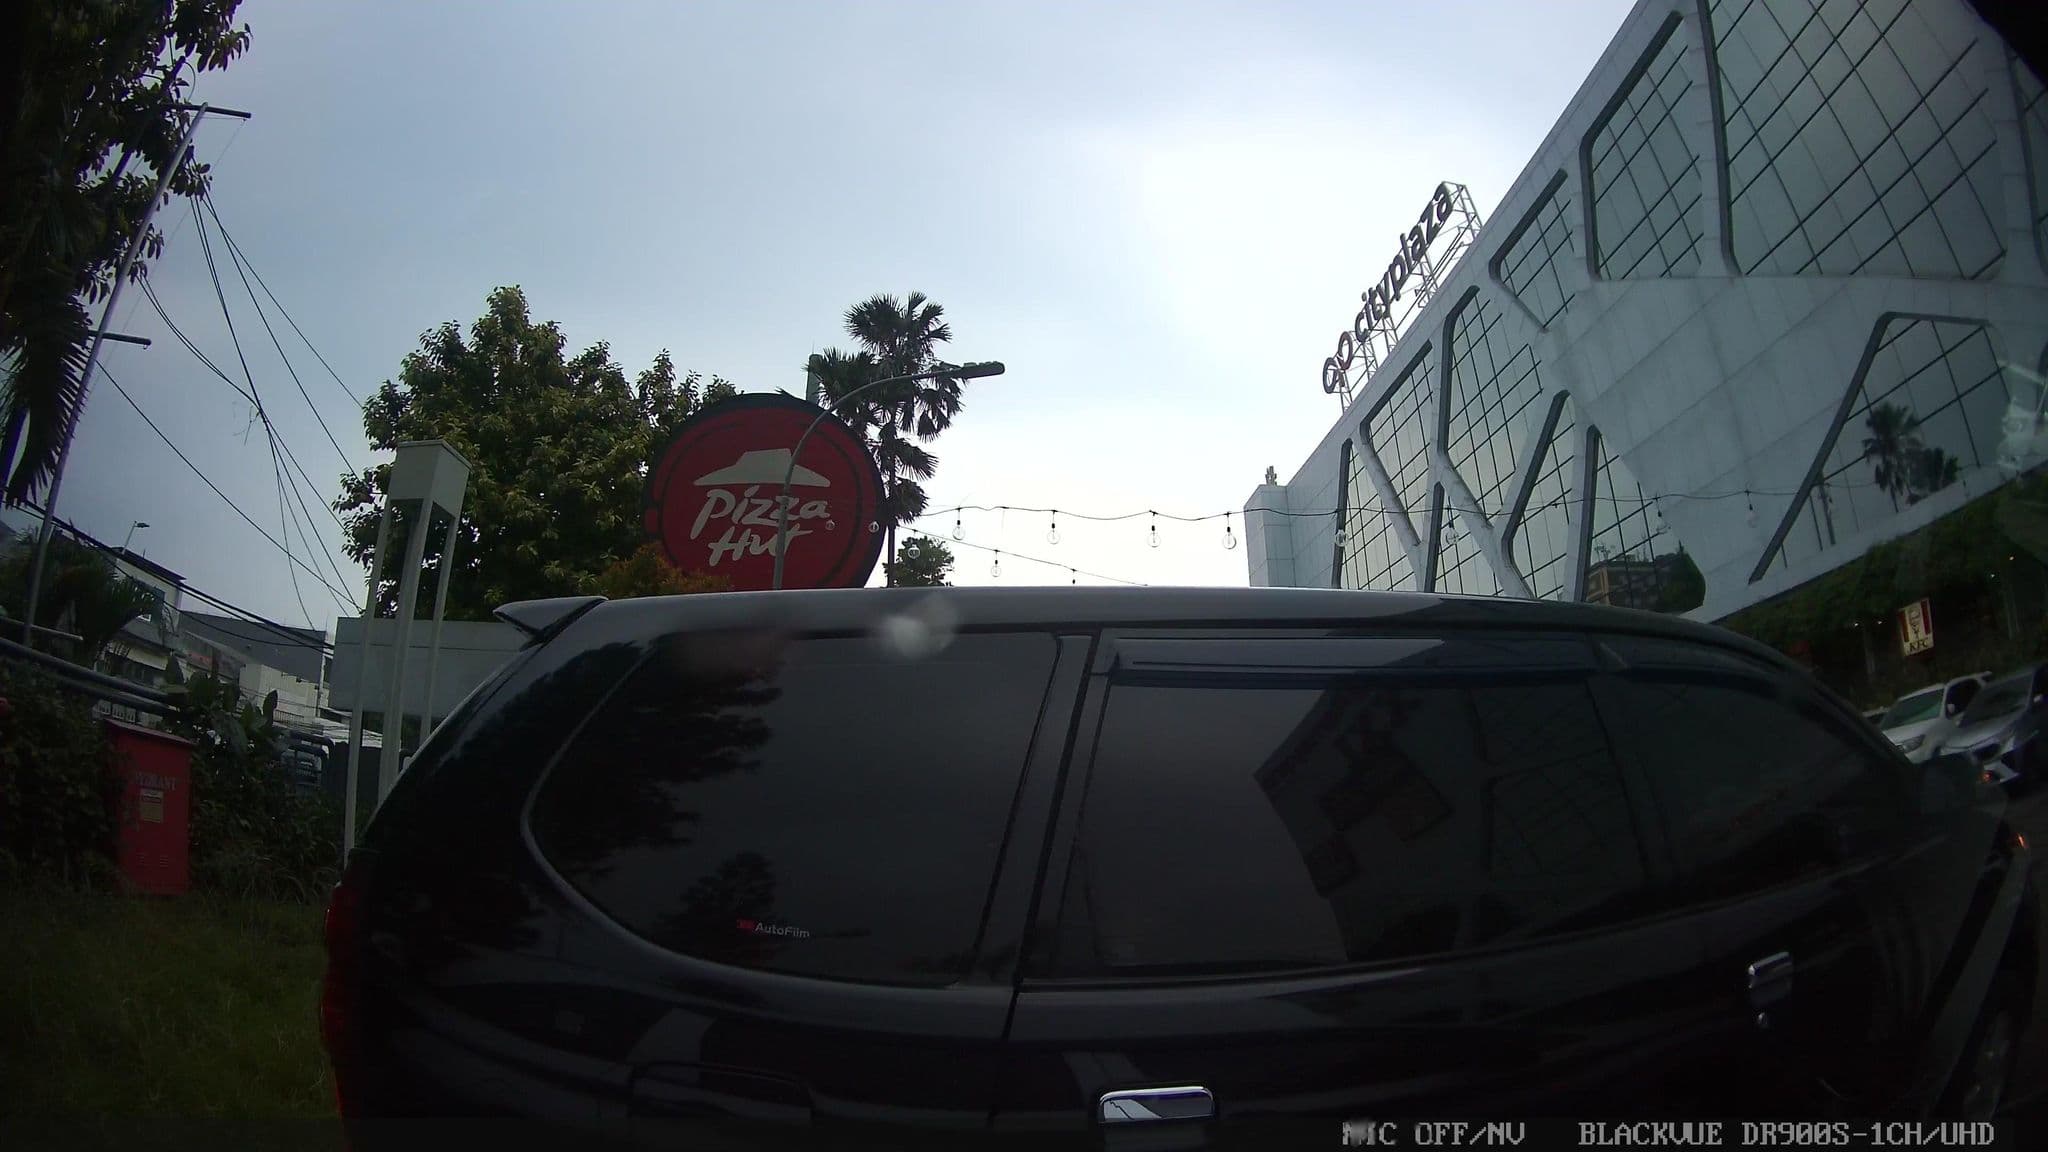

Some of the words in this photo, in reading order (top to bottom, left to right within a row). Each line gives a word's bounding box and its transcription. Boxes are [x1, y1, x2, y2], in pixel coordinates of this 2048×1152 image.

[1355, 181, 1453, 343] cityplaza
[690, 485, 829, 540] Pizza
[708, 526, 813, 567] Hut
[1910, 637, 1930, 652] KFC
